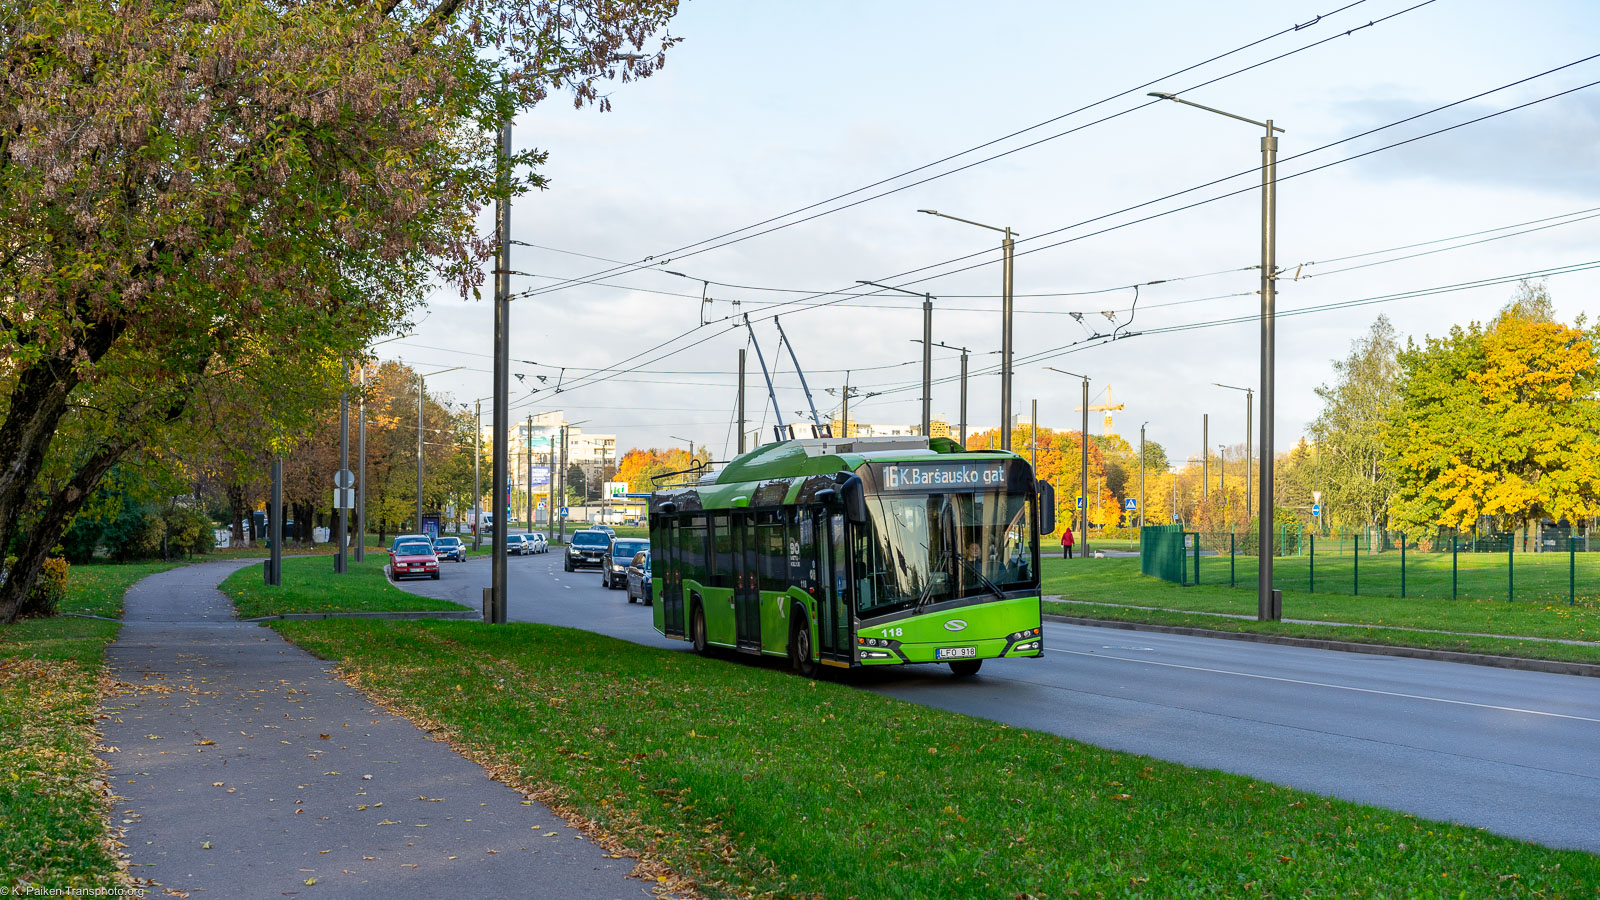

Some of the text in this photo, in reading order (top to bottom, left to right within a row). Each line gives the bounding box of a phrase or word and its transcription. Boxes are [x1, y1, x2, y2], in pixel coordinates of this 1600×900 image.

[883, 466, 899, 487] 16
[983, 466, 1005, 486] gat
[881, 627, 903, 638] 118
[940, 647, 975, 657] LFO 918
